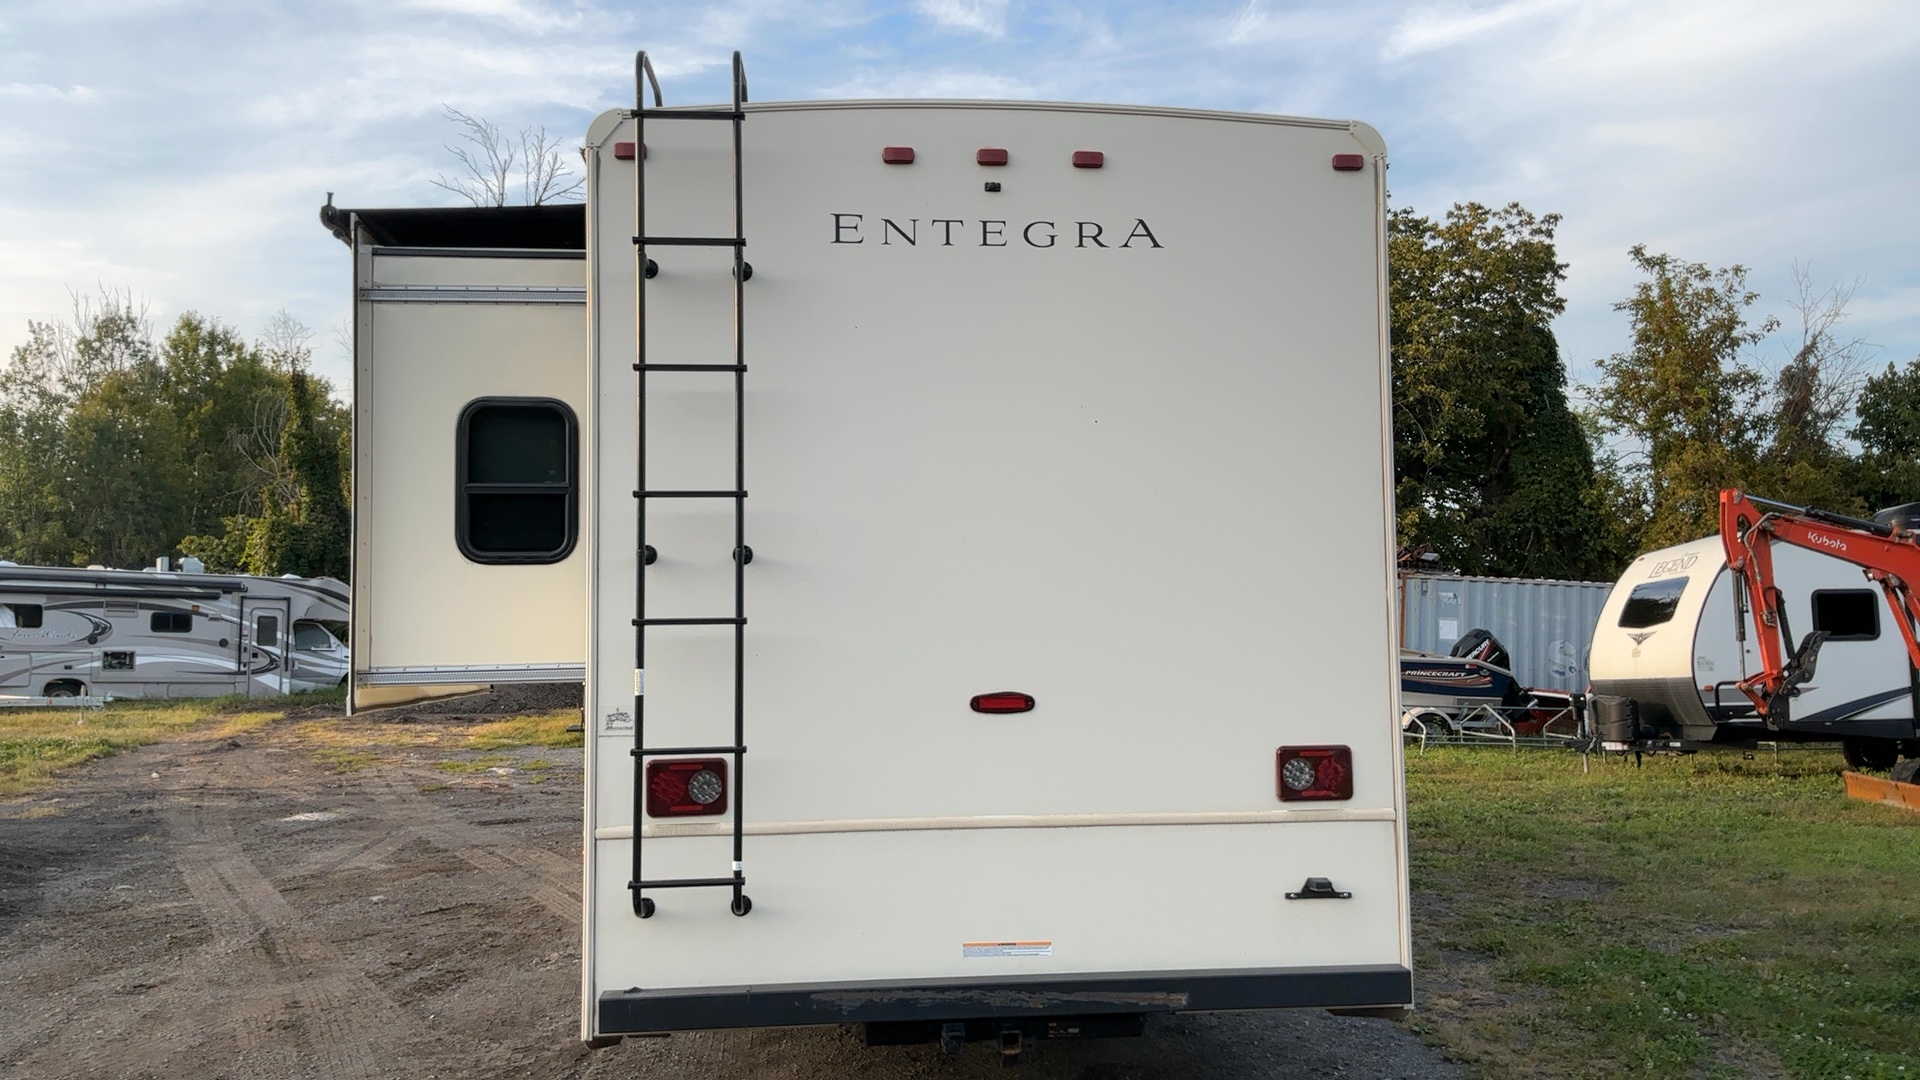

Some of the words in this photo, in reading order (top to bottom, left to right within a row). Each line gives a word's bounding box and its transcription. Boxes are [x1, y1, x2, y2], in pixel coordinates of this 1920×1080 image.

[830, 212, 1165, 249] ENTEGRA
[1807, 531, 1847, 551] Kubota
[1648, 556, 1698, 578] LEGEND
